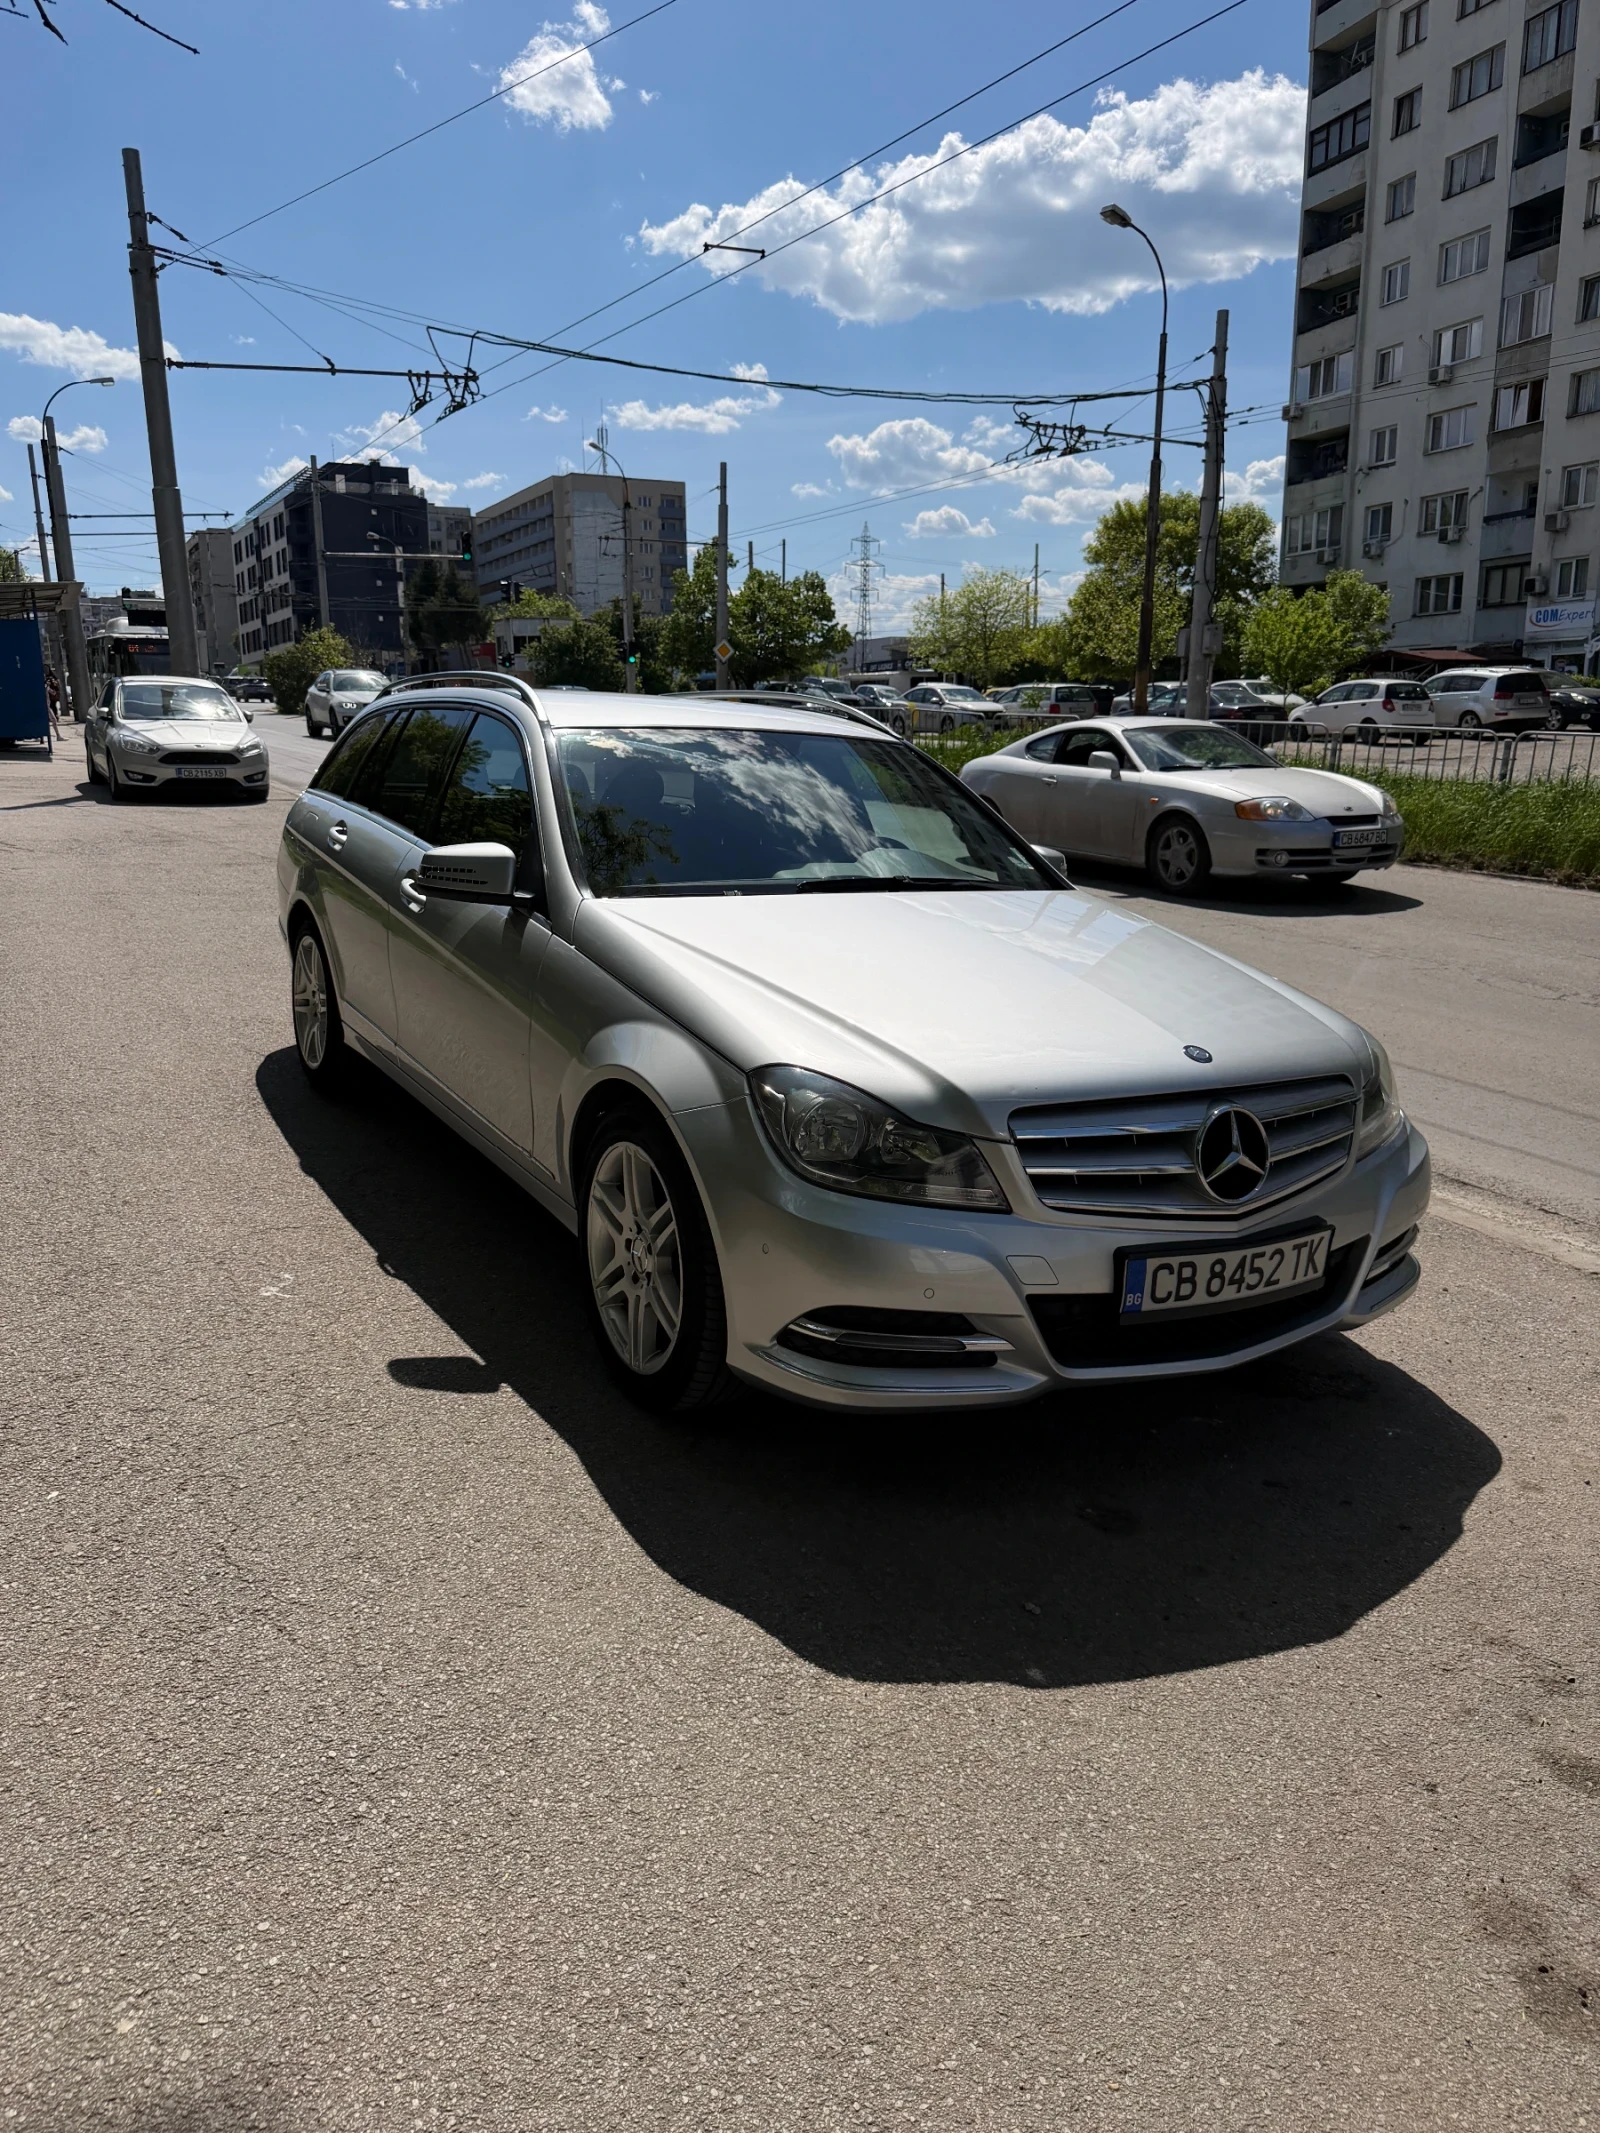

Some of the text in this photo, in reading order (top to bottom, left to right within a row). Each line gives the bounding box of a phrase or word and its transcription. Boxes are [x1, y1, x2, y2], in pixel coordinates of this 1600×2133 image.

[1341, 831, 1386, 844] CB 6847 BC
[1150, 1236, 1325, 1304] CB 8452 TK
[1126, 1293, 1142, 1306] BG
